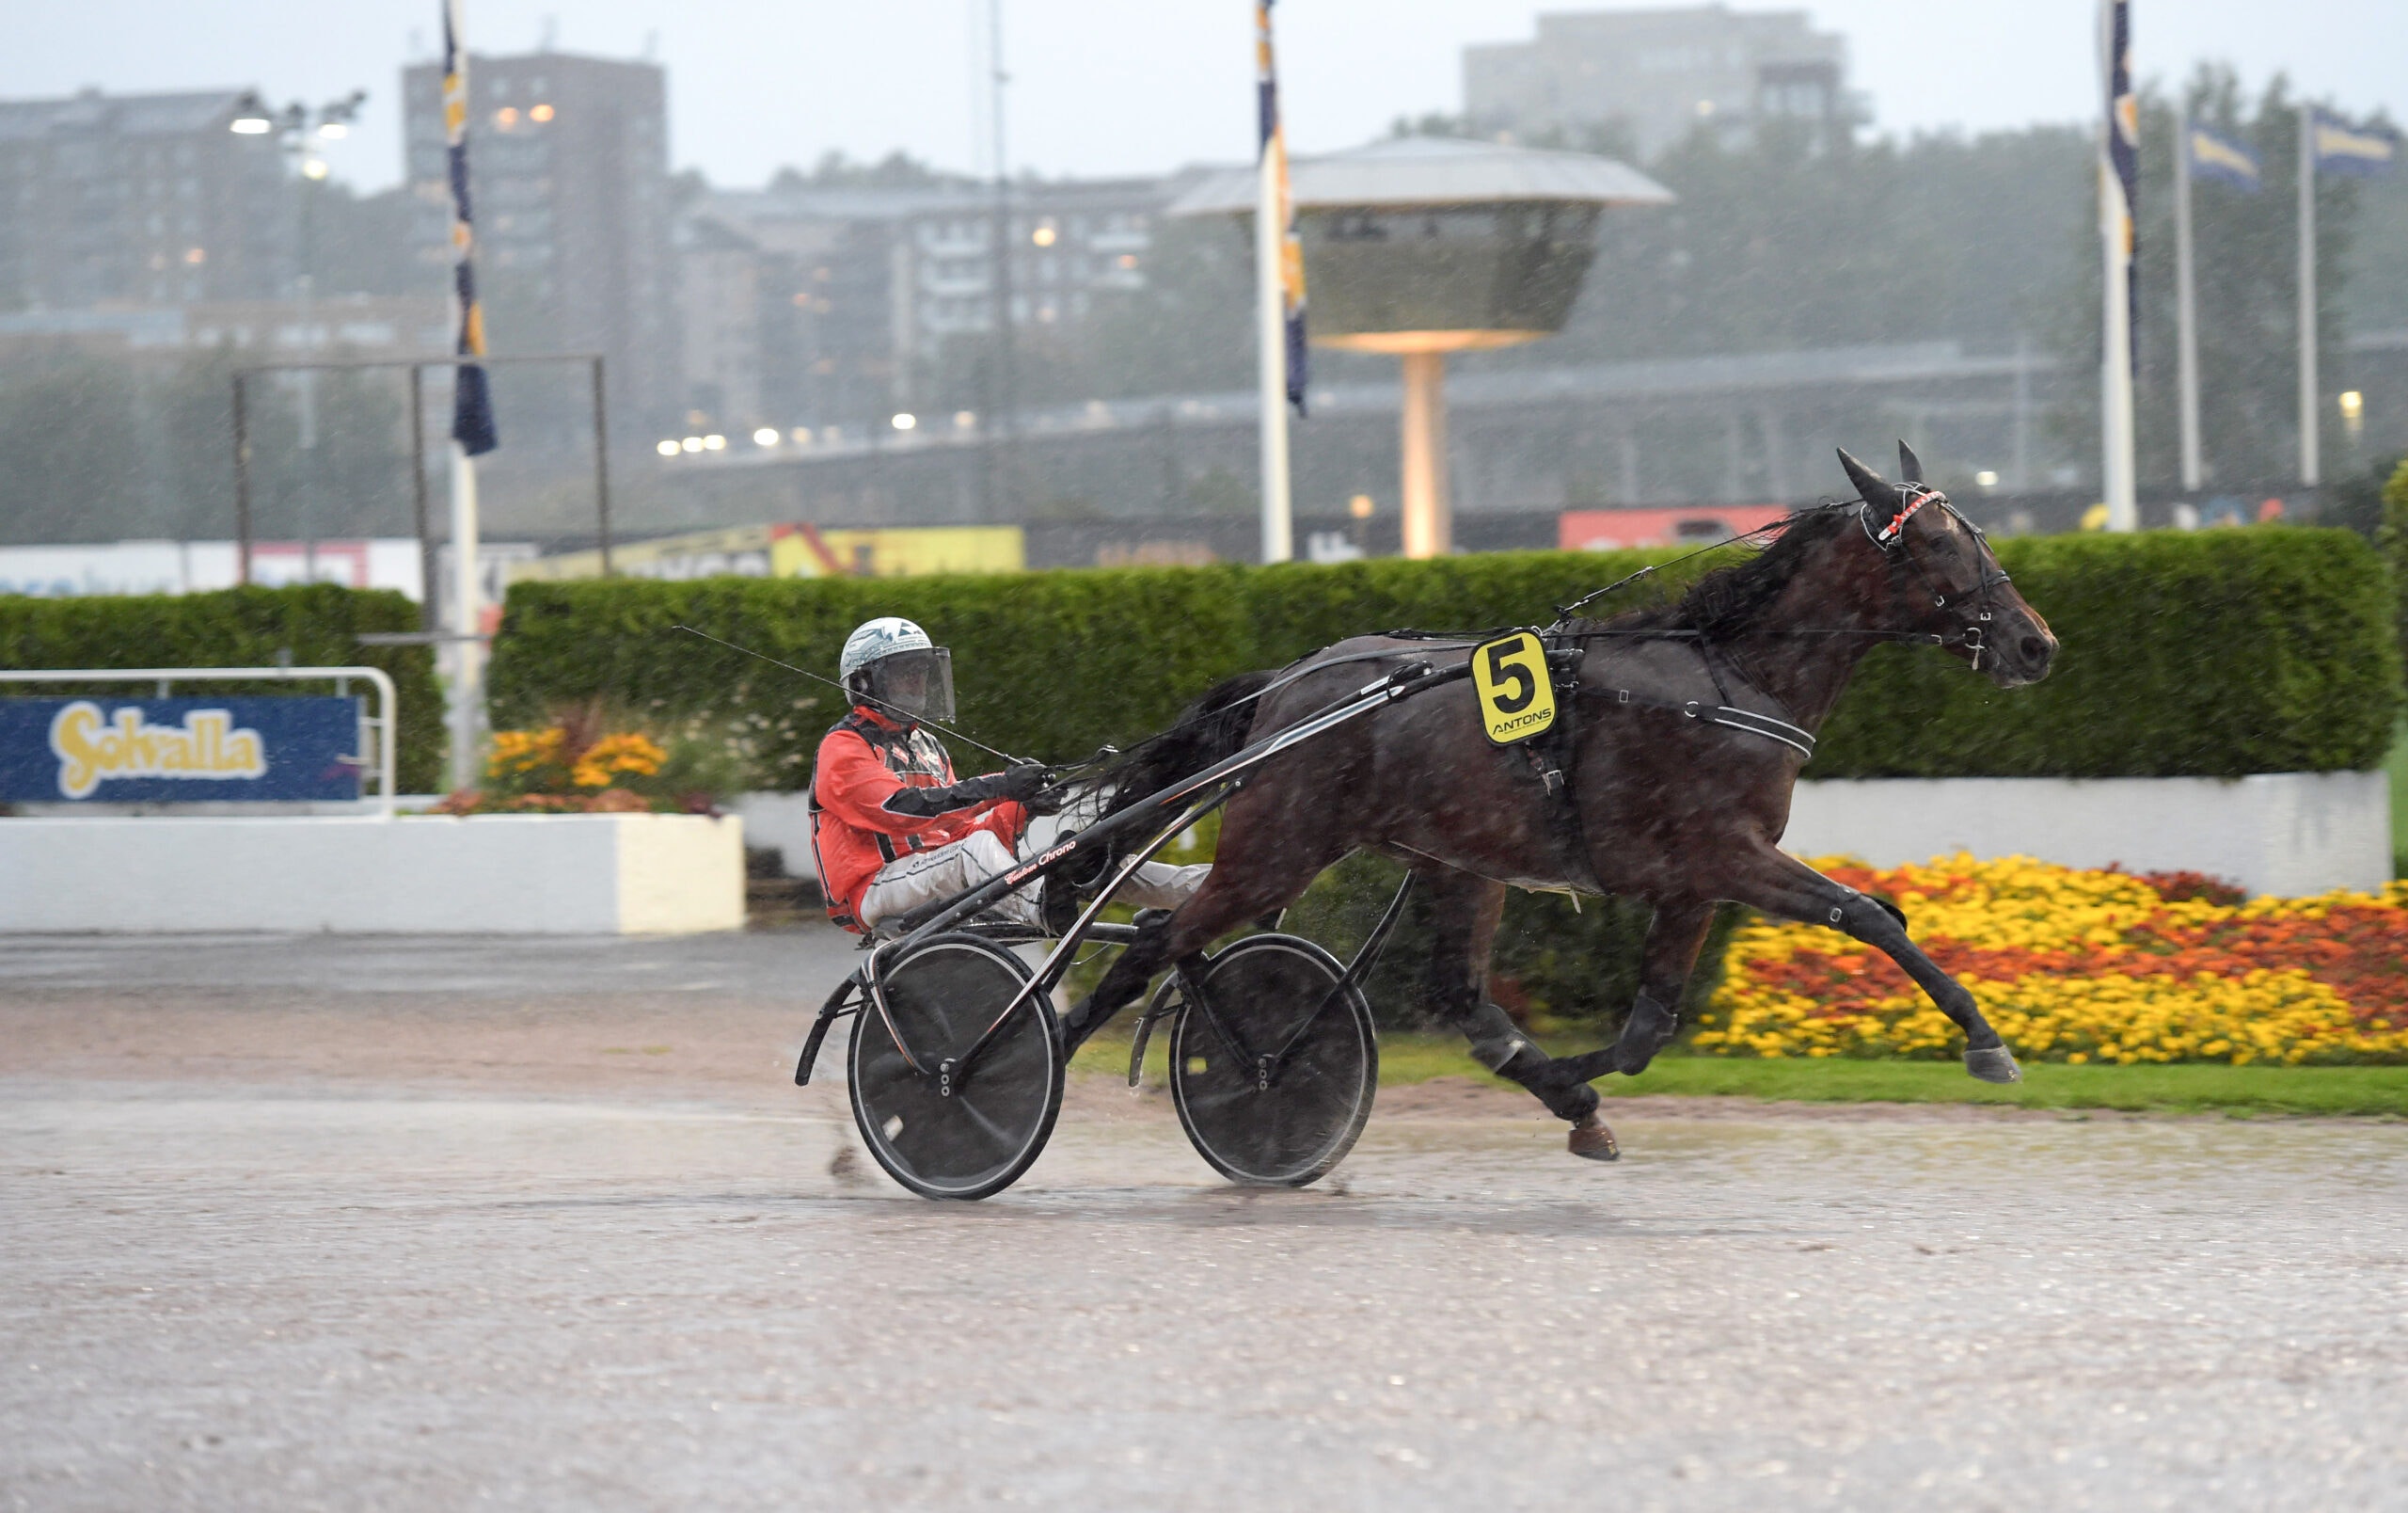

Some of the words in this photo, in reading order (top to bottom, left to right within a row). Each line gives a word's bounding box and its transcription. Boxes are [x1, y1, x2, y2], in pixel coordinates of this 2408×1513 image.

[1487, 637, 1535, 714] 5
[1493, 708, 1552, 735] ANTONS
[54, 704, 262, 796] Solvalla
[1038, 840, 1076, 866] Chrono
